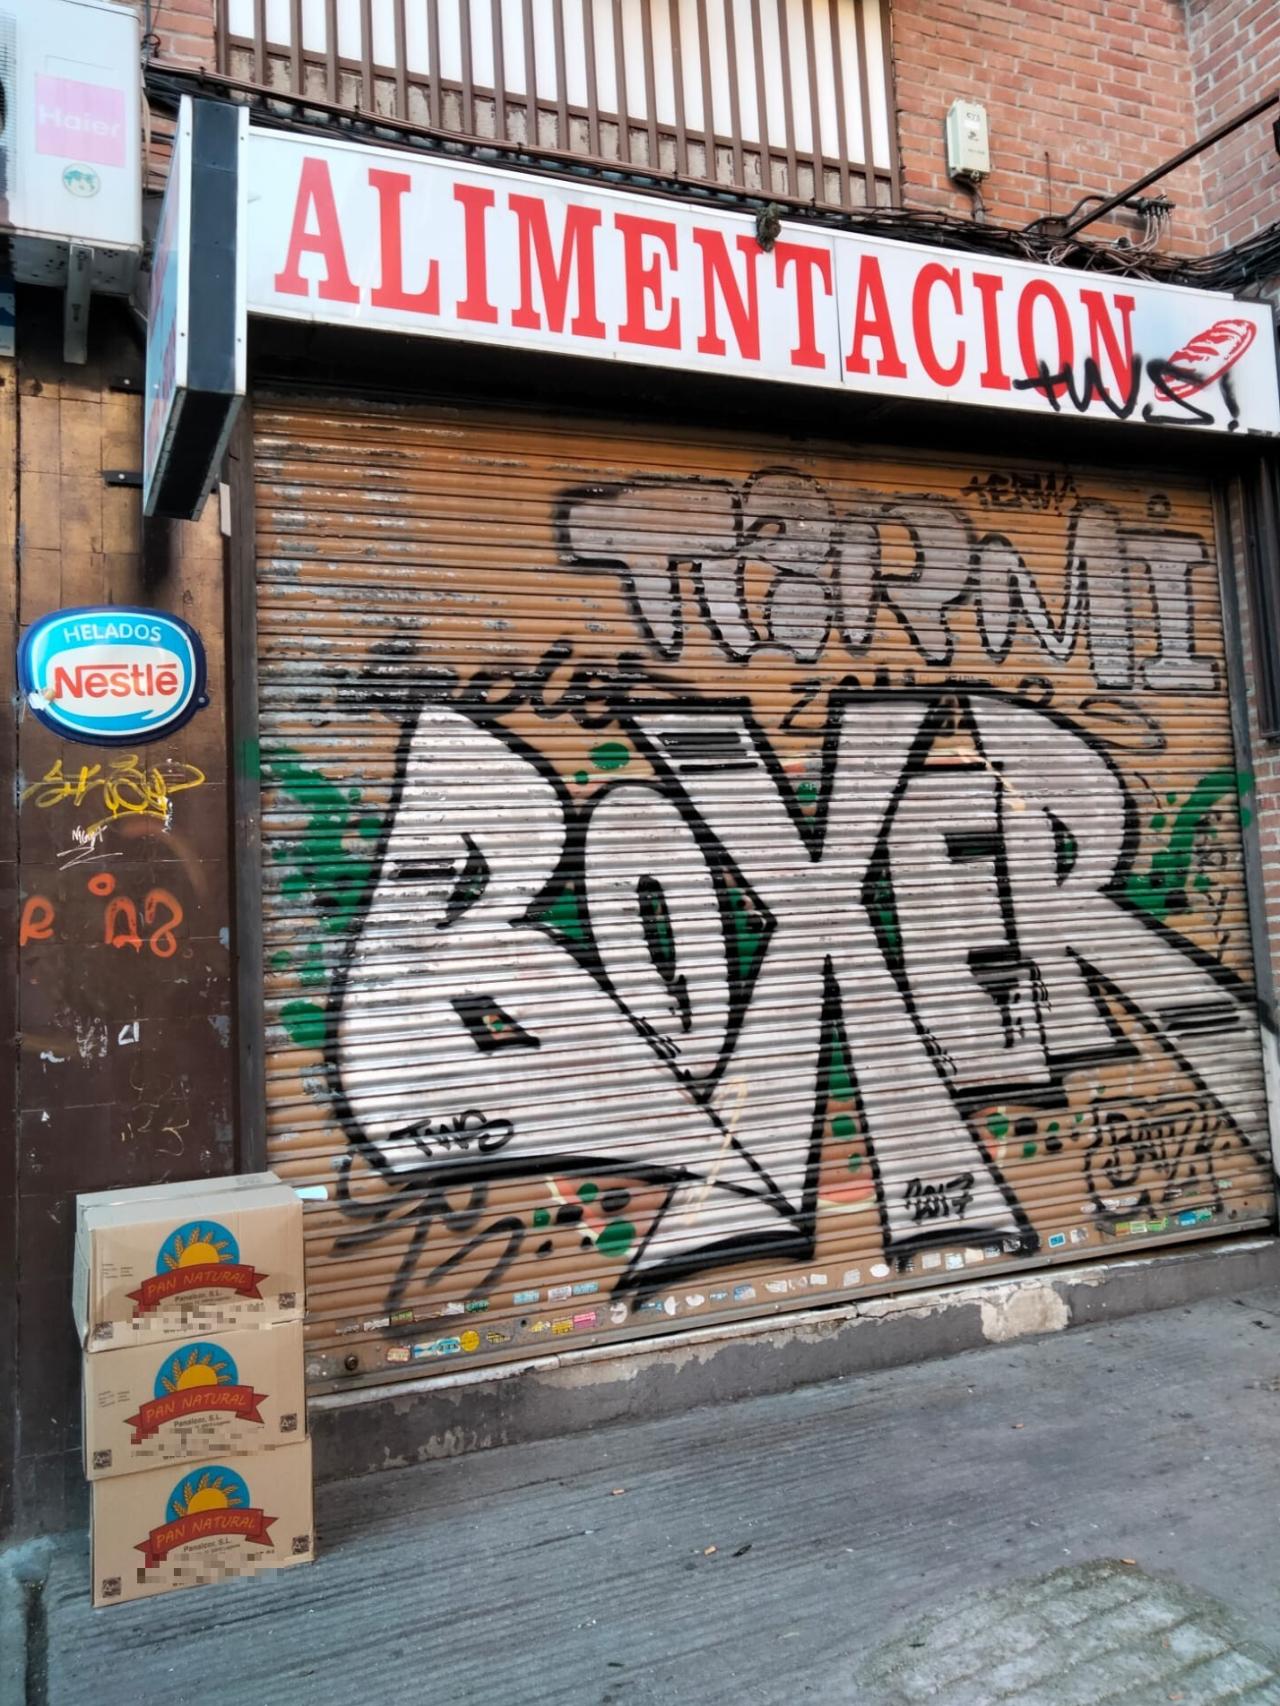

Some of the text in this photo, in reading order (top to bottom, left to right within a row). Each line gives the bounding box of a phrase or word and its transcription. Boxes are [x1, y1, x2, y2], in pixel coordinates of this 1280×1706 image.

[37, 103, 122, 140] Haier
[273, 156, 1136, 406] ALIMENTACION
[63, 623, 162, 643] HELADOS
[54, 662, 179, 700] Nestlé
[148, 1270, 247, 1298] PAN NATURAL
[146, 1392, 247, 1423] PAN NATURAL
[156, 1516, 256, 1548] PAN NATURAL
